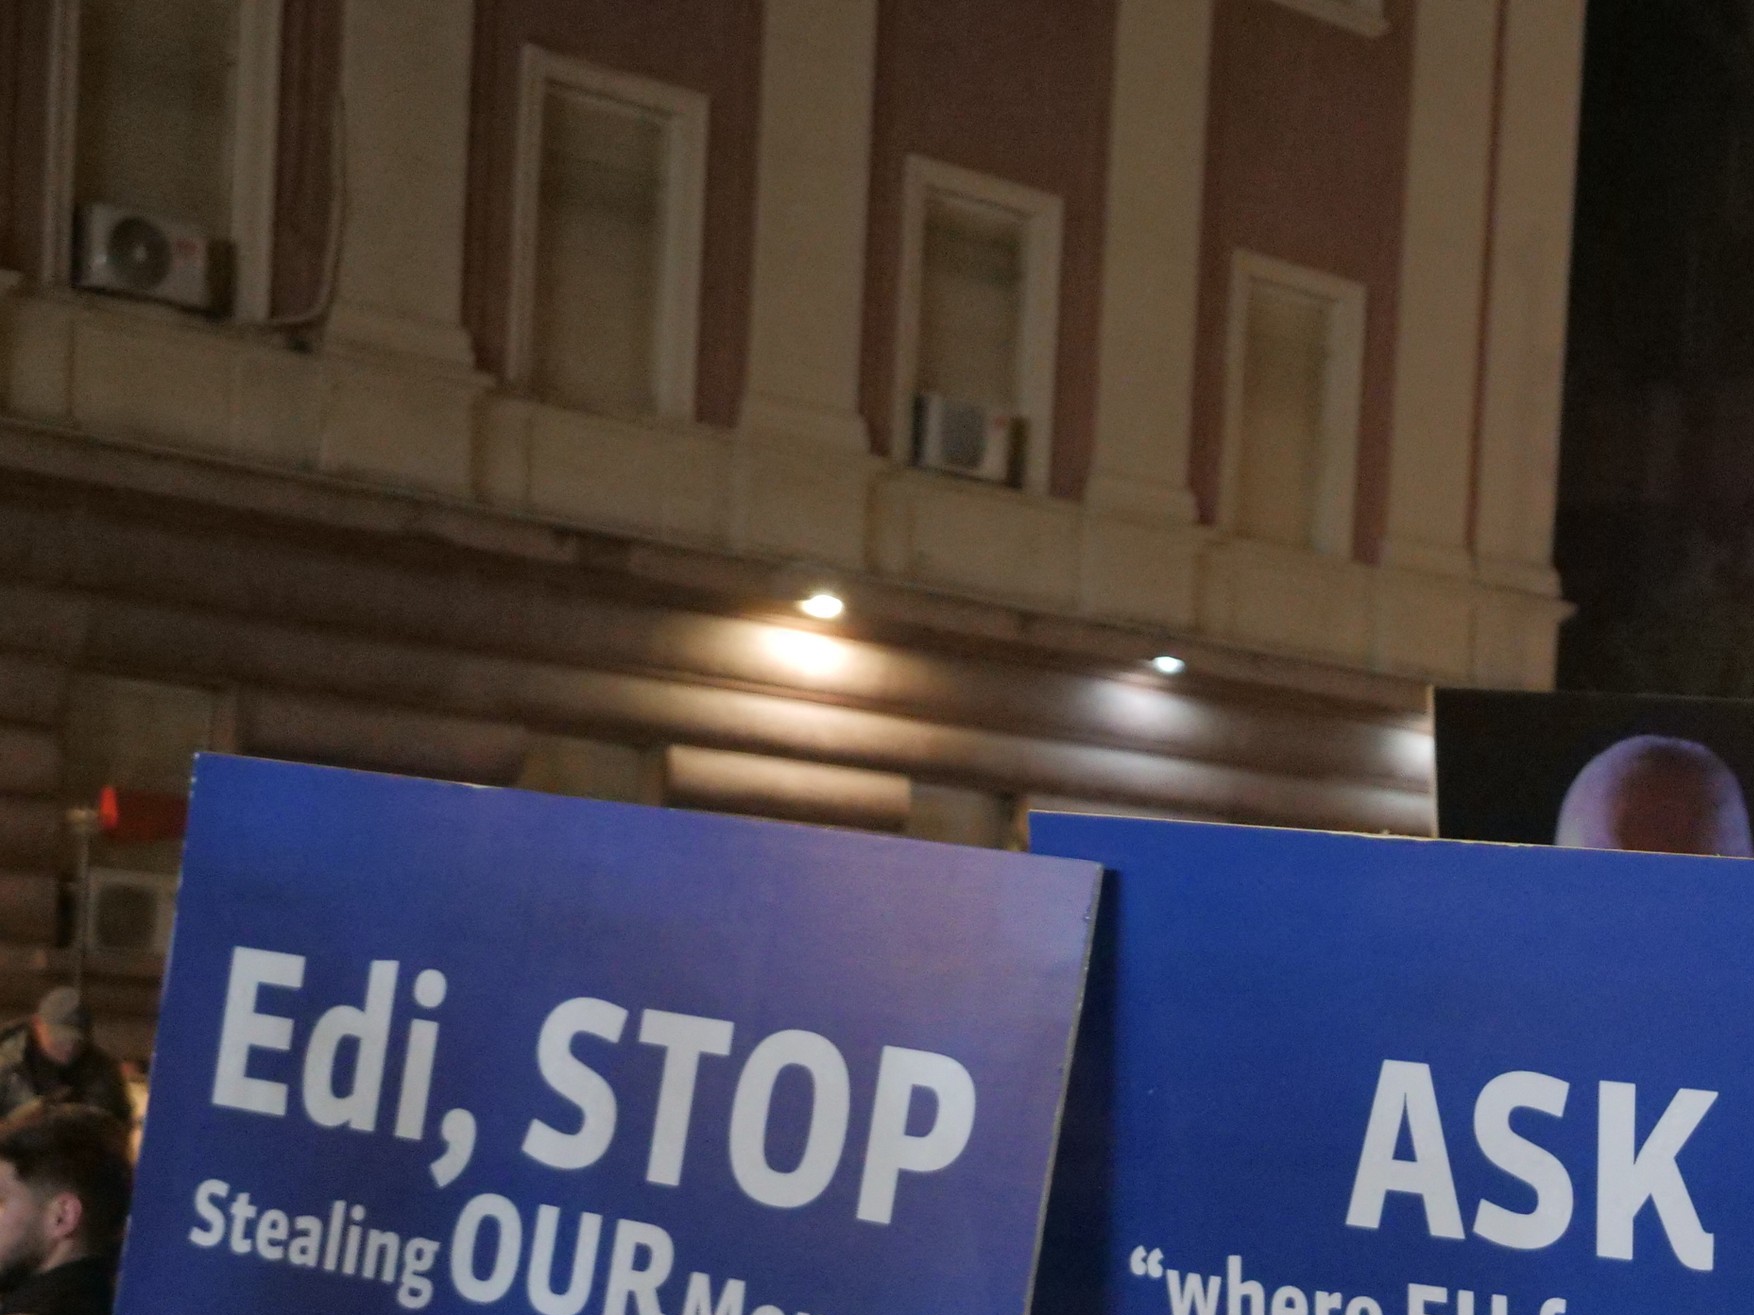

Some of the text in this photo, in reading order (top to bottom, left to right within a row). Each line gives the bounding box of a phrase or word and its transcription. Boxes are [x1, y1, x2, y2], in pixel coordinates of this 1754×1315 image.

[212, 946, 978, 1226] Edi, STOP
[1345, 1059, 1720, 1272] ASK
[189, 1178, 441, 1310] Stealing
